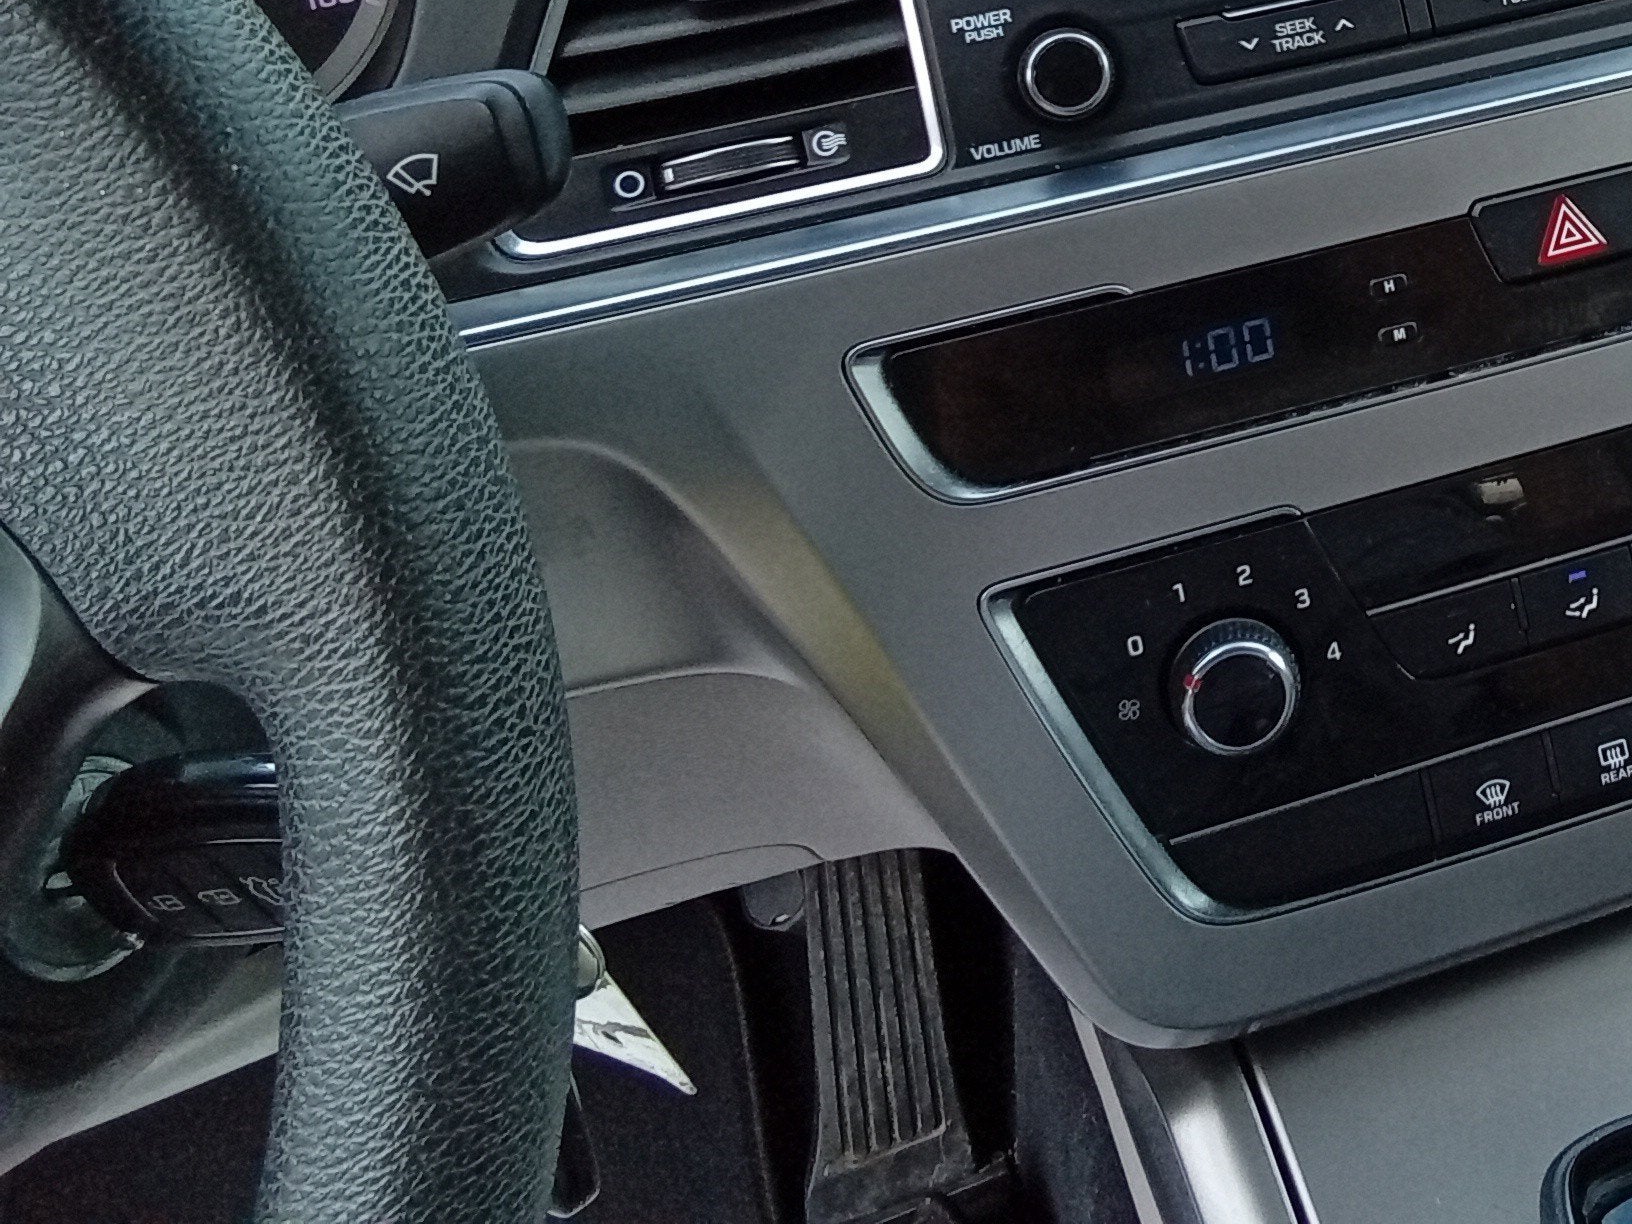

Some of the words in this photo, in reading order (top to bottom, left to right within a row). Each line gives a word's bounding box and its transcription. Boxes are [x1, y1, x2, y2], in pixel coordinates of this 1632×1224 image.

[950, 8, 1013, 34] POWER
[1274, 16, 1318, 37] SEEK
[964, 26, 1005, 44] PUSH
[1271, 30, 1325, 53] TRACK
[969, 133, 1042, 161] VOLUME
[1383, 279, 1396, 294] H
[1392, 327, 1407, 342] M
[1181, 317, 1275, 377] 1:00
[1235, 564, 1253, 587] 2
[1171, 582, 1187, 604] 1
[1294, 588, 1311, 610] 3
[1126, 634, 1144, 657] 0
[1326, 641, 1342, 661] 4
[1475, 800, 1520, 827] FRONT
